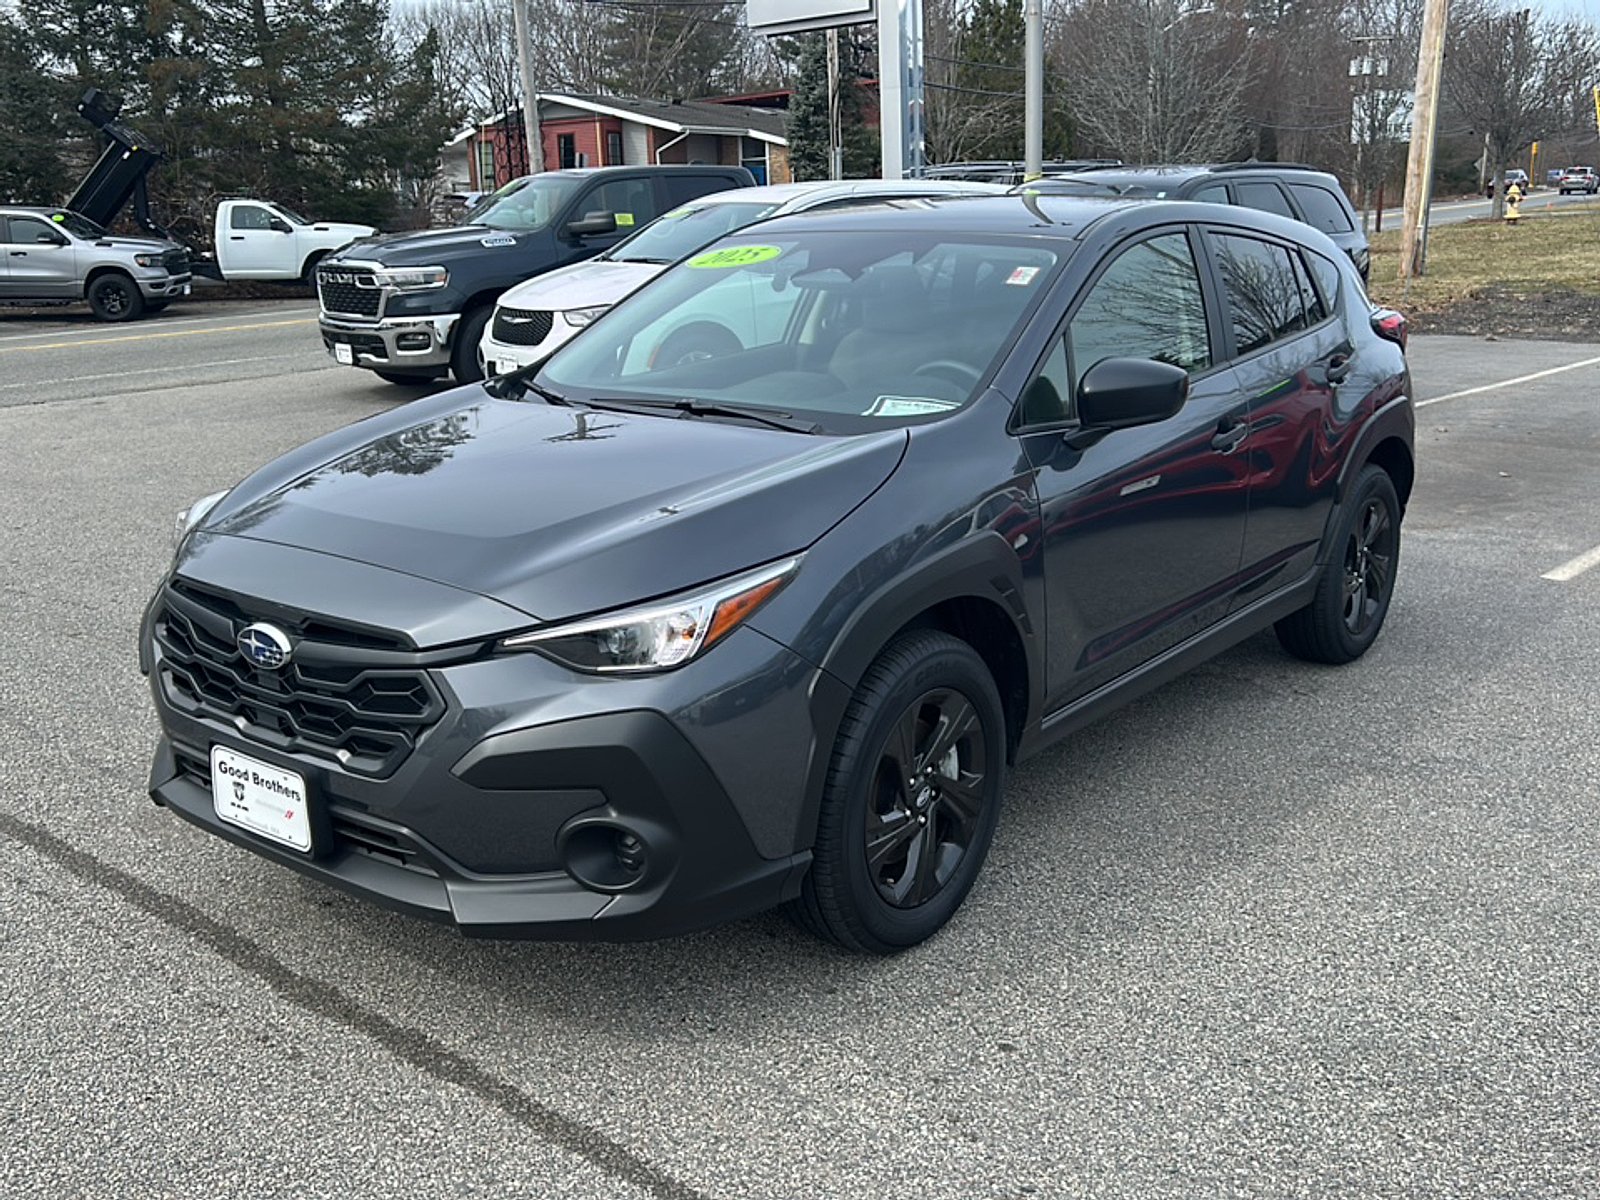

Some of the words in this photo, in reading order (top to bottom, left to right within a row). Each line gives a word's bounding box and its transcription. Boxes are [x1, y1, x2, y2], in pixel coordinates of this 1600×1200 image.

[695, 247, 770, 265] 2025
[218, 760, 249, 782] Good
[252, 772, 302, 802] Brothers
